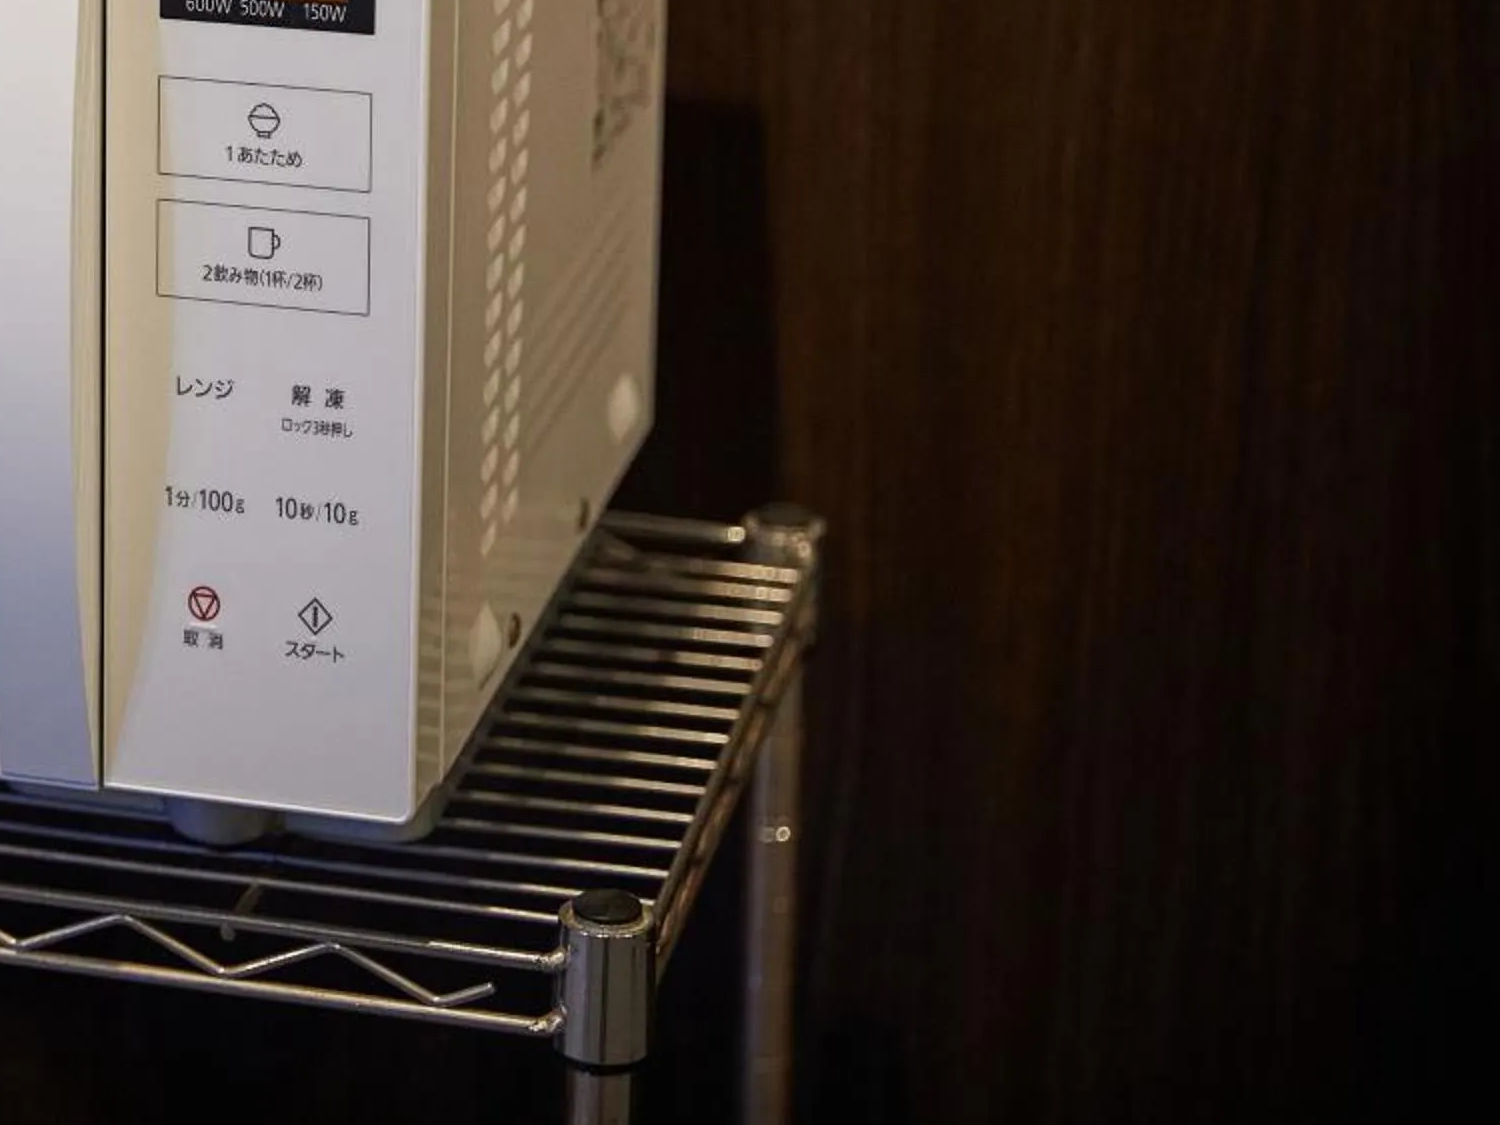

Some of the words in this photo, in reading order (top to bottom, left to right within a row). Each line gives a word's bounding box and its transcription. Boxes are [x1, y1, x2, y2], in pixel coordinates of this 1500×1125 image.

[303, 2, 347, 23] 150W
[176, 375, 235, 400] レンジ
[284, 640, 345, 664] スタート
